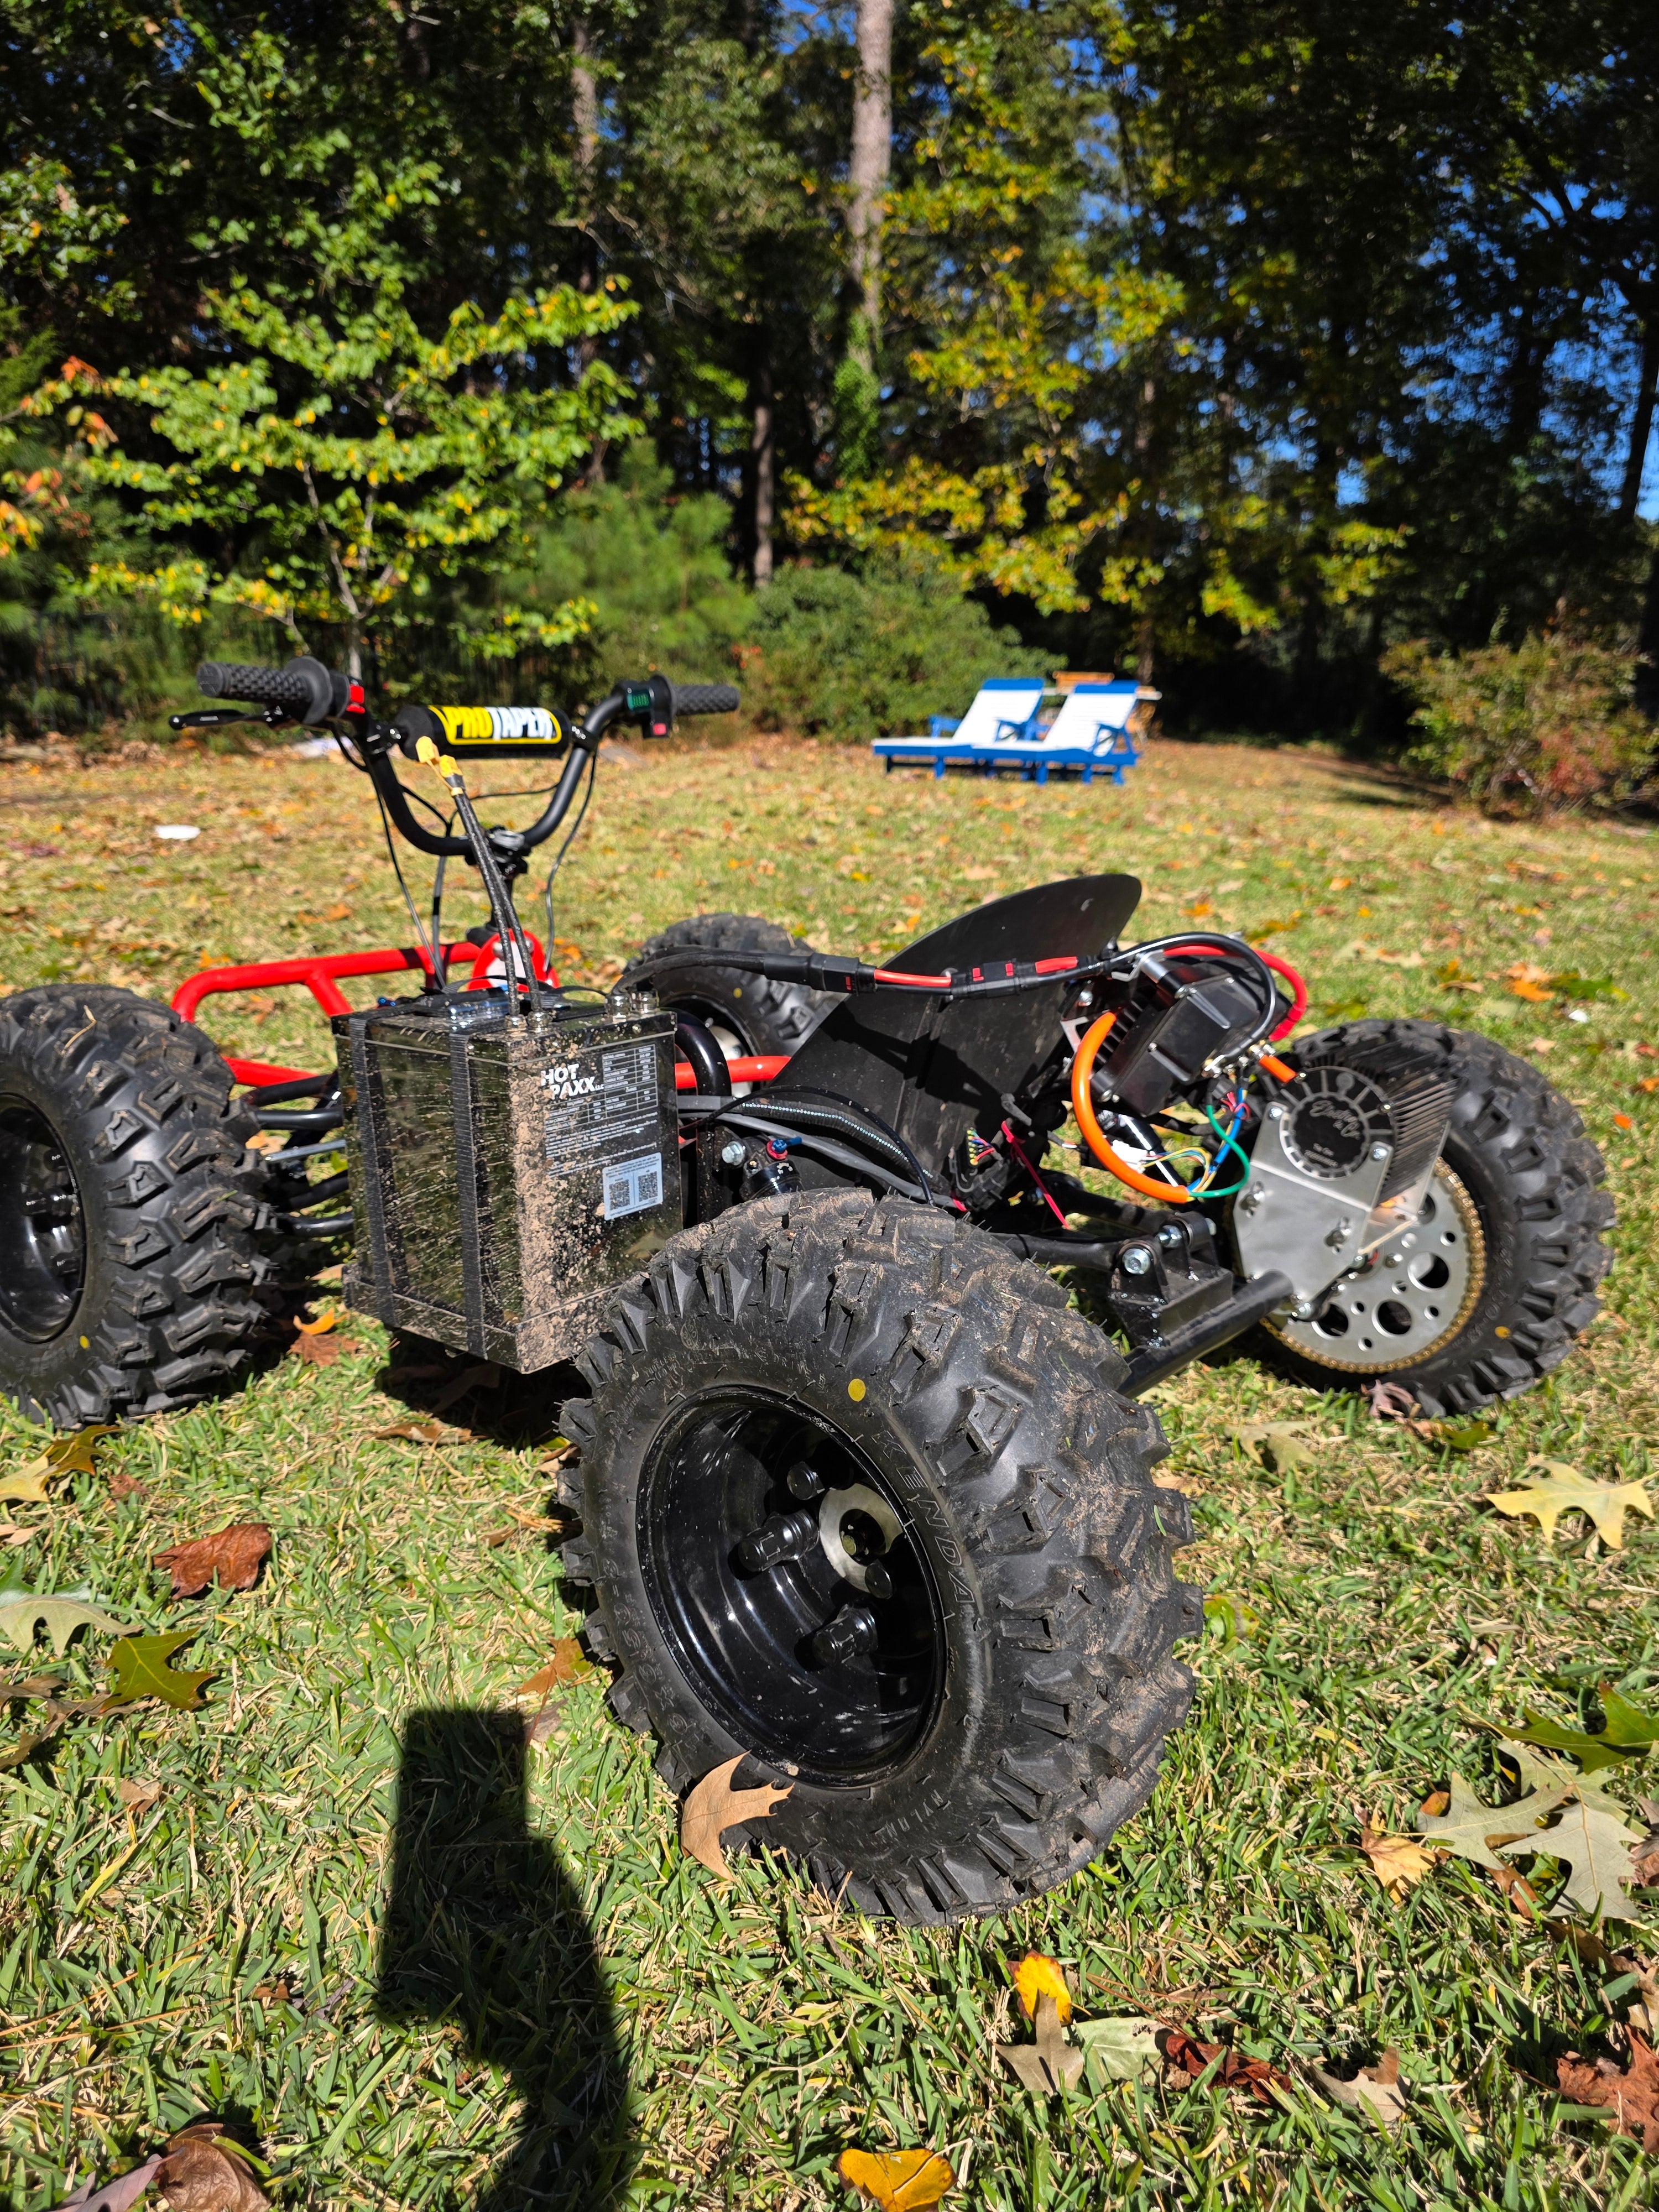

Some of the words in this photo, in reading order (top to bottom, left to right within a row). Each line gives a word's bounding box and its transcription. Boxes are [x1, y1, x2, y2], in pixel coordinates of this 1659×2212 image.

[540, 1063, 580, 1086] HOT
[551, 1076, 596, 1100] PAXX
[871, 1430, 975, 1603] KENDA
